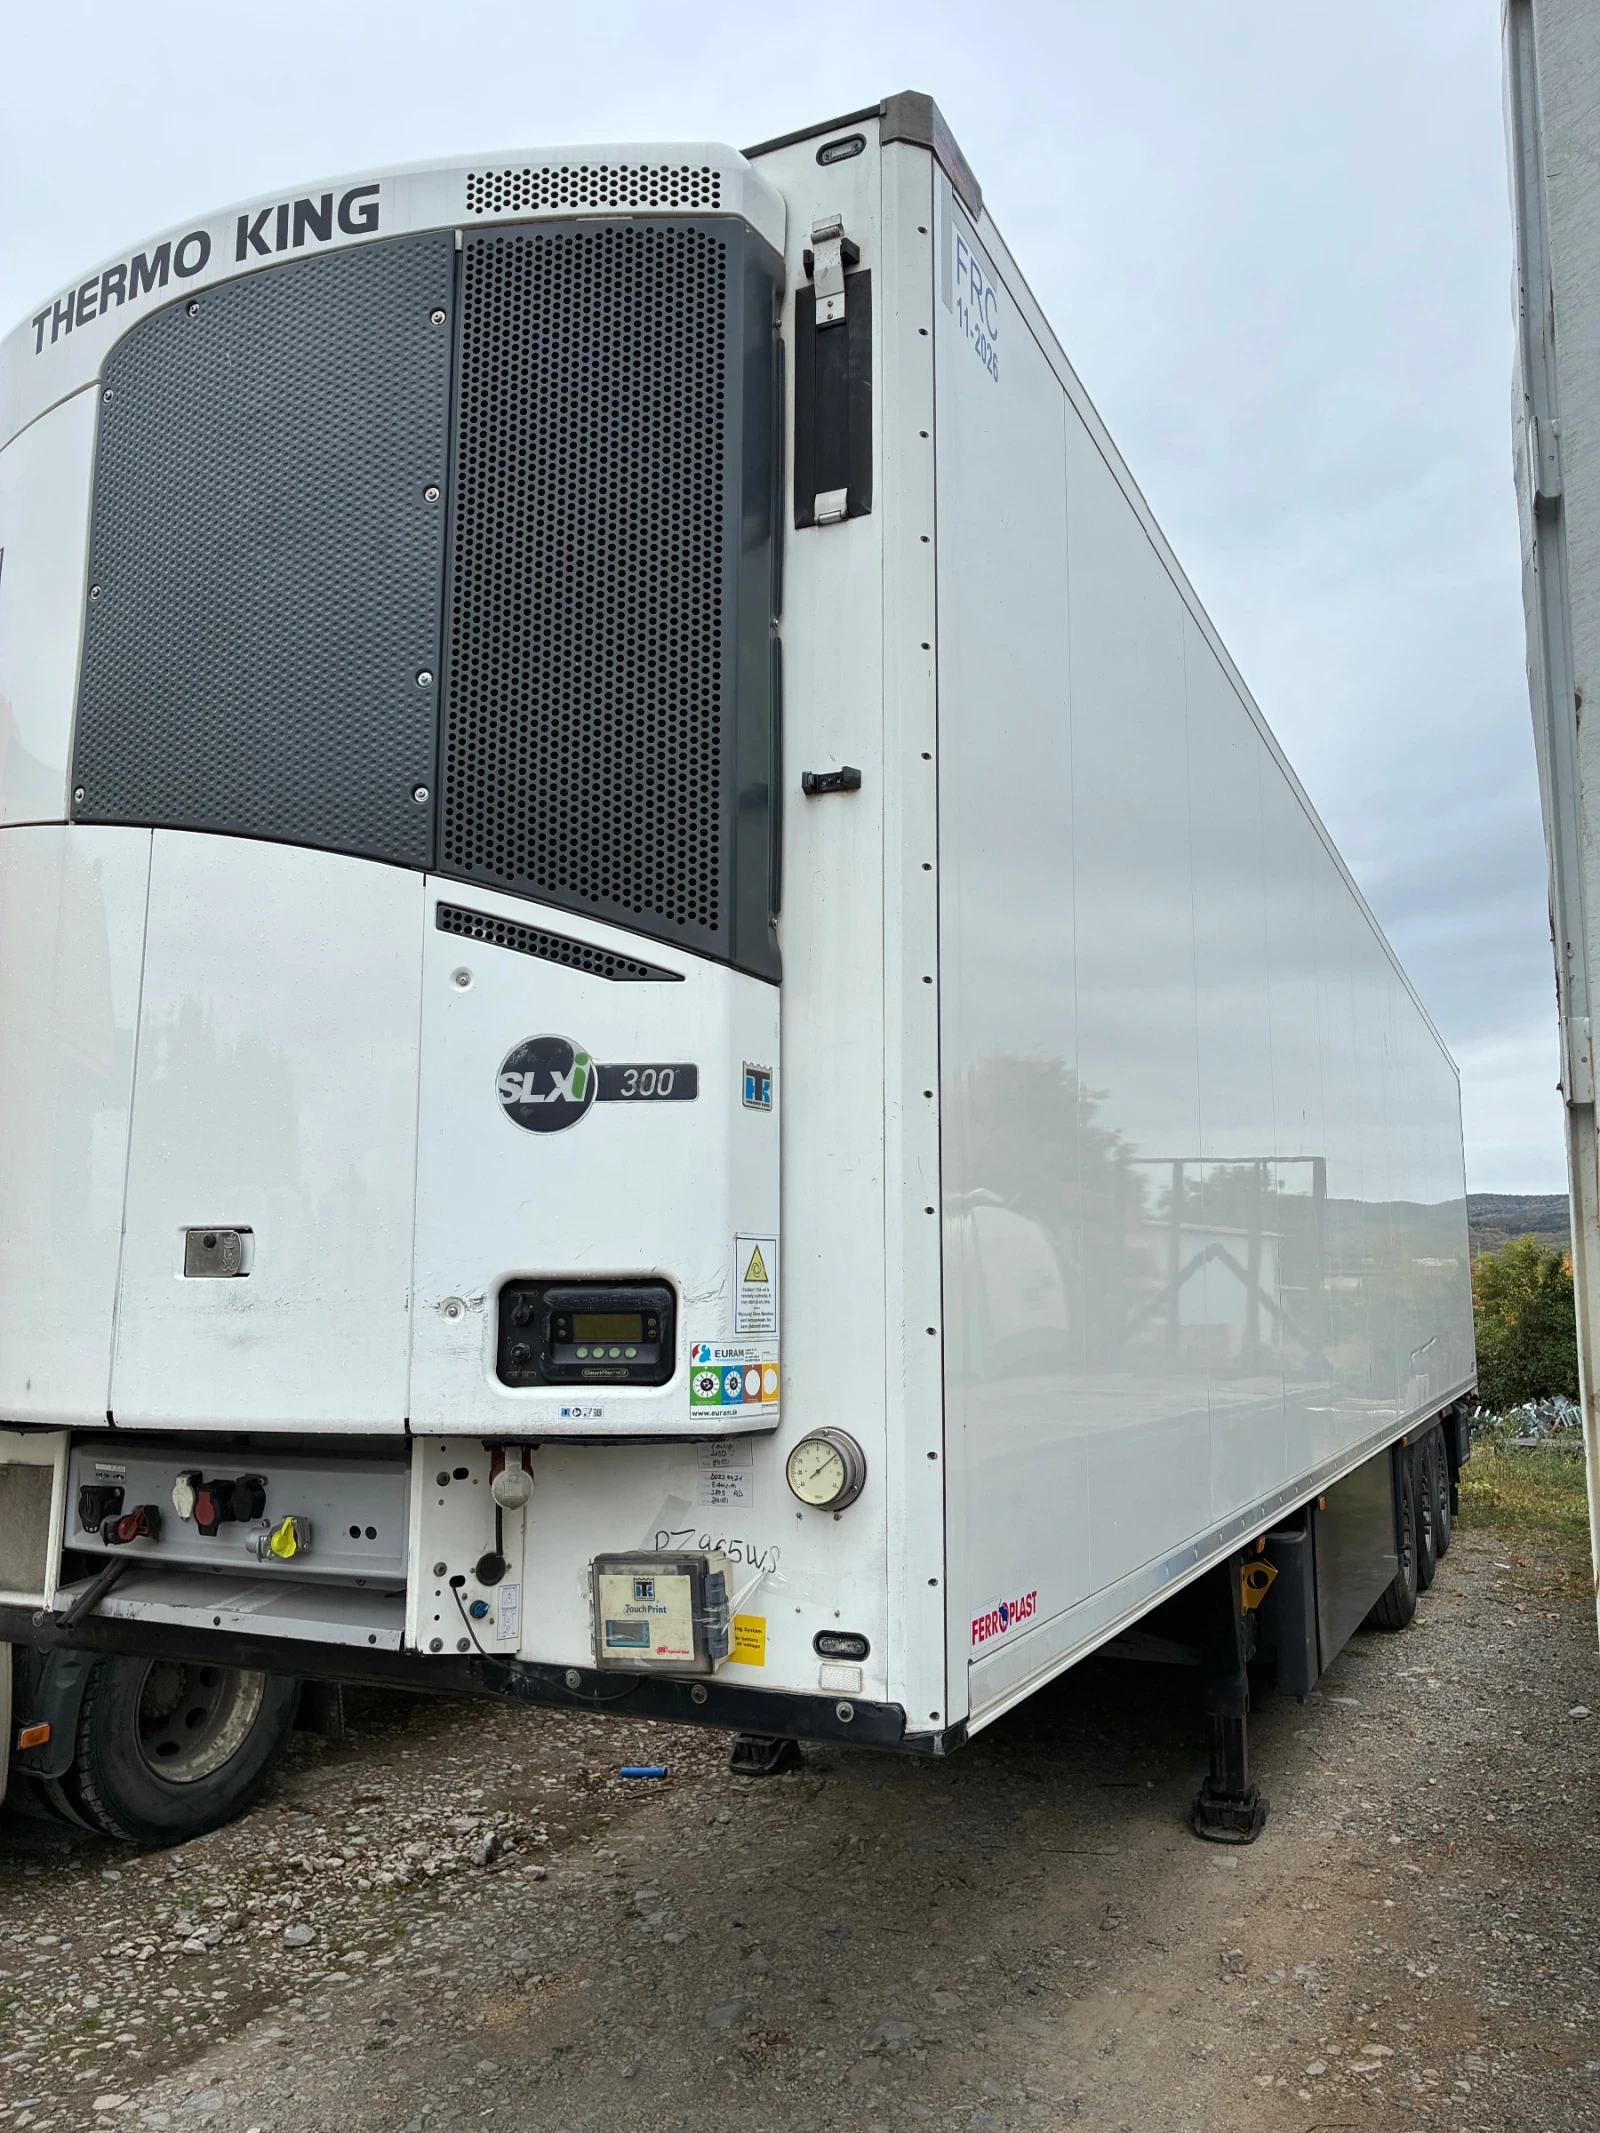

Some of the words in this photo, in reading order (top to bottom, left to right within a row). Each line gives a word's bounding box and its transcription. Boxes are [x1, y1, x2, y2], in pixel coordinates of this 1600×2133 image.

[32, 230, 212, 356] THERMO
[235, 183, 381, 263] KING
[957, 233, 998, 342] FRC
[957, 297, 999, 383] 11-2026
[498, 1051, 590, 1104] SLXi
[620, 1068, 675, 1097] 300
[714, 1348, 745, 1358] EURAM
[692, 1409, 737, 1417] www.euram.de
[972, 1590, 1037, 1646] FERROPLAST
